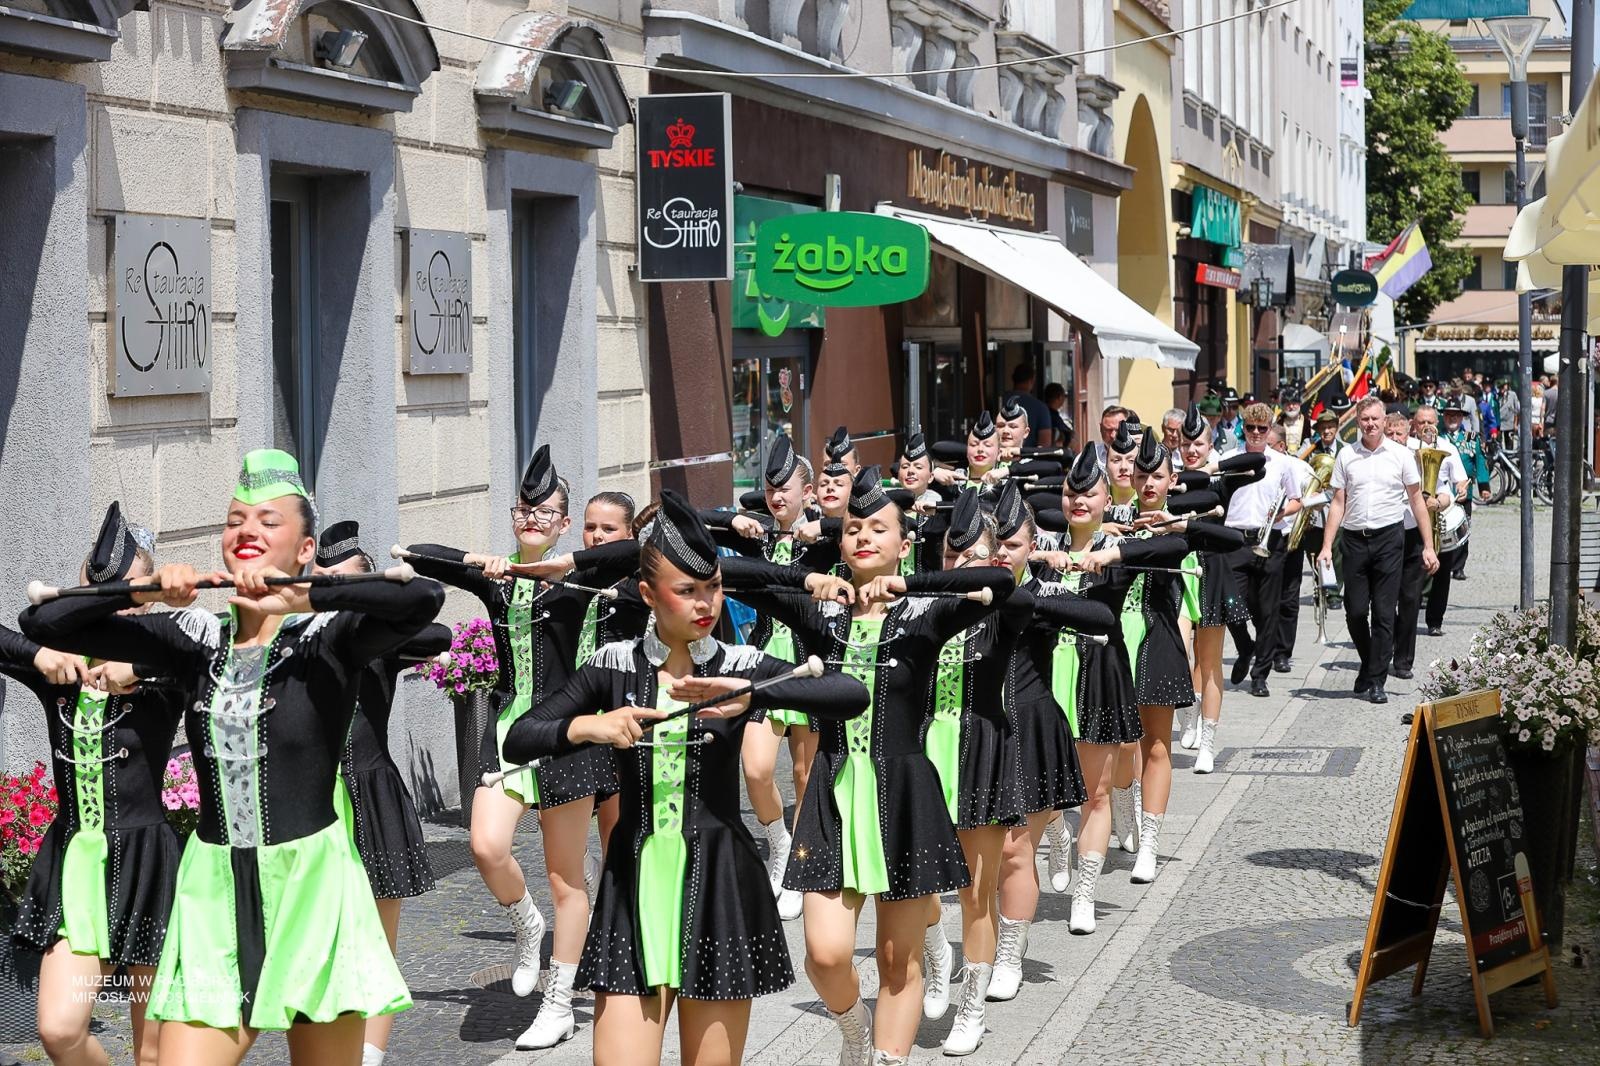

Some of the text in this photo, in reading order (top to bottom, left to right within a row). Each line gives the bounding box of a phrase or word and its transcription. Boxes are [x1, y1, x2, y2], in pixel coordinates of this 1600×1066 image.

[648, 148, 716, 168] TYSKIE
[772, 233, 908, 275] żabka
[1455, 699, 1480, 719] TYSKIE
[1471, 846, 1492, 867] PIZZA
